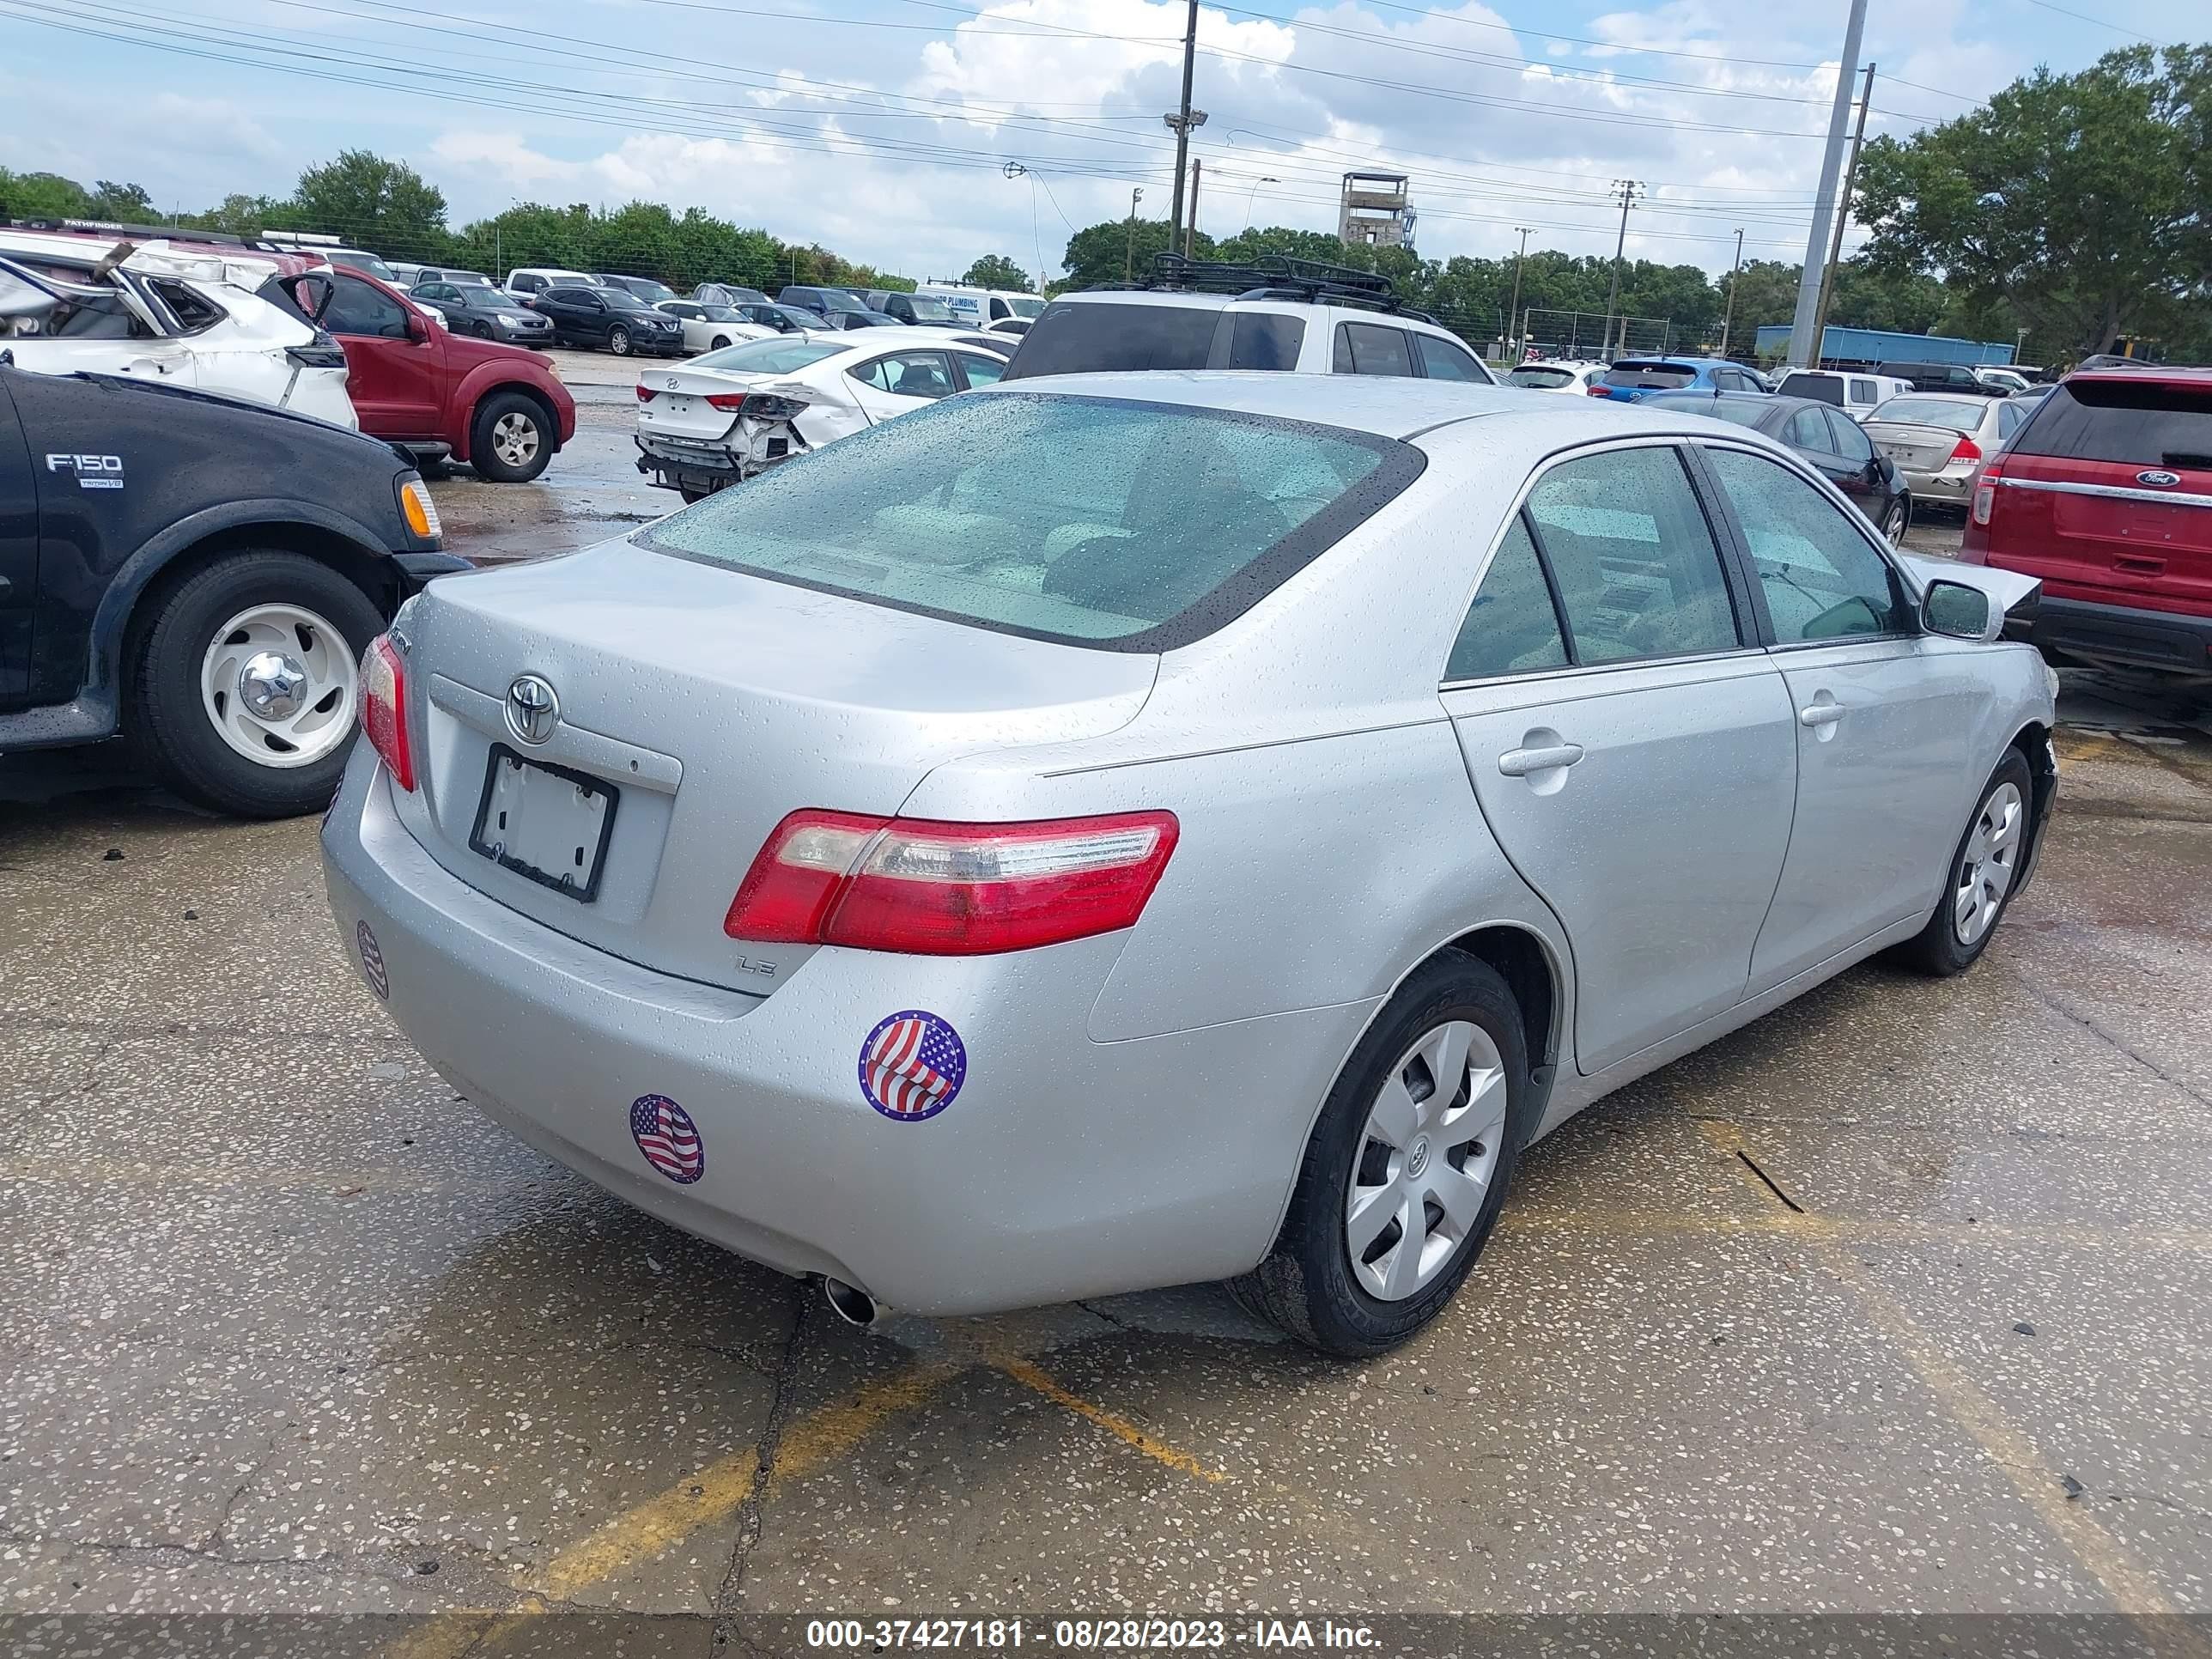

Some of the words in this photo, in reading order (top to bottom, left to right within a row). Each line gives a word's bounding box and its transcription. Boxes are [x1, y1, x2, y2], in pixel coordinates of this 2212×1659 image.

[64, 219, 124, 231] PATHFINDER
[948, 296, 978, 308] PLUMBING
[736, 955, 777, 978] LE
